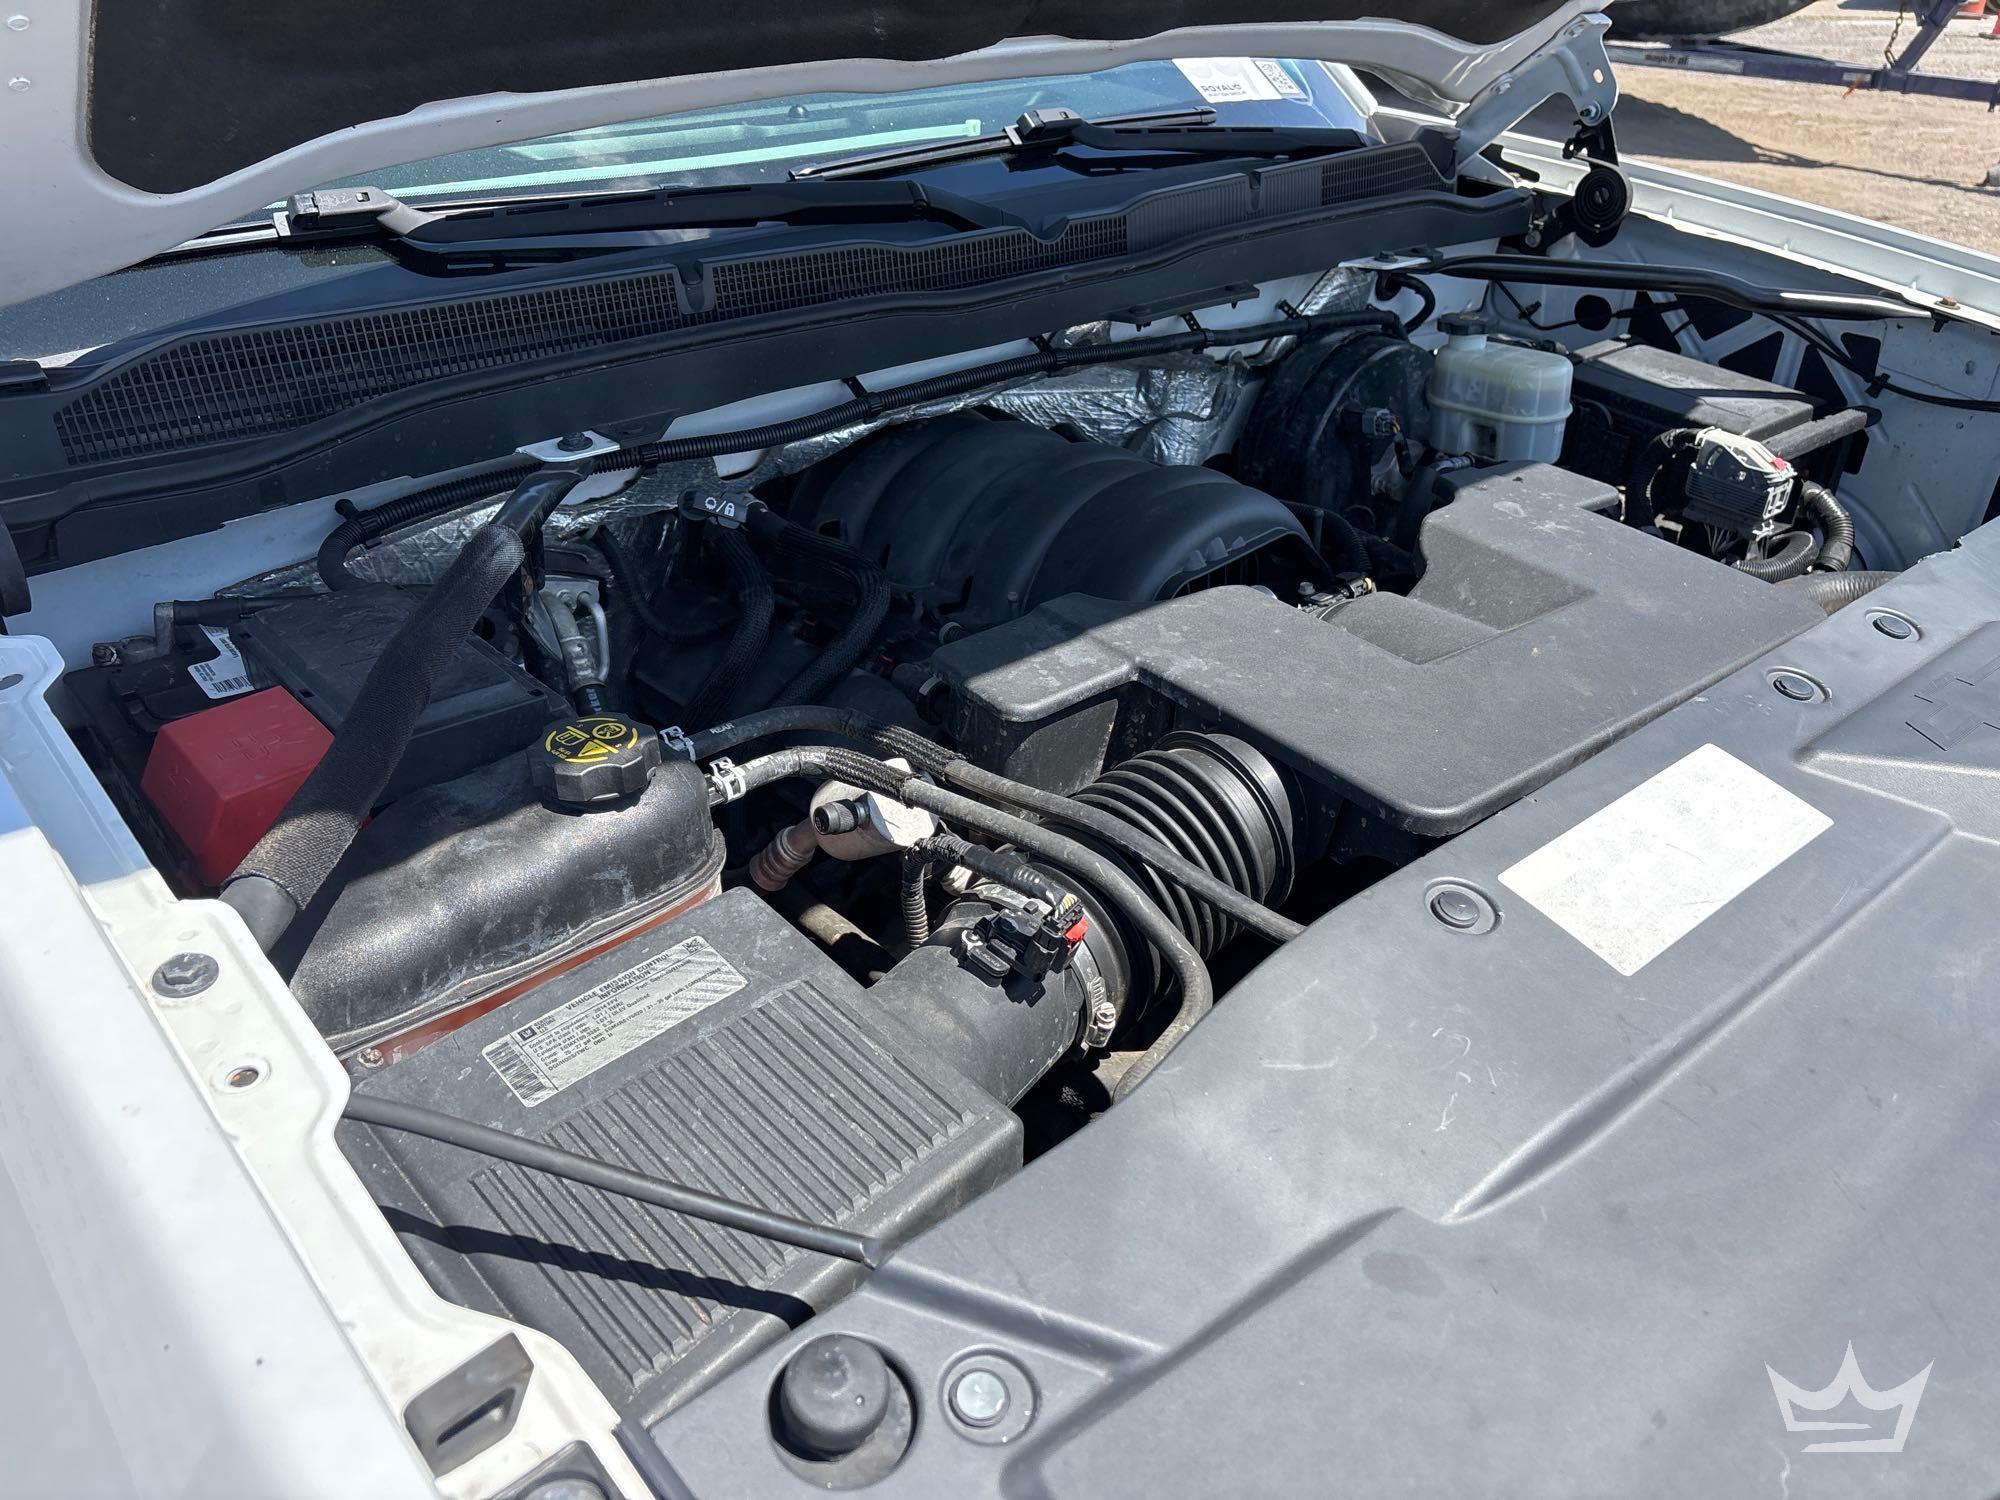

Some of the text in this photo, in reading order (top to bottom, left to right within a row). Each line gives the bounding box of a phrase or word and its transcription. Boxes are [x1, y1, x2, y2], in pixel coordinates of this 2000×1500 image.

[709, 722, 735, 734] REAR
[565, 953, 670, 1010] VEHICLE EMISSION CONTROL
[598, 970, 651, 1000] INFORMATION
